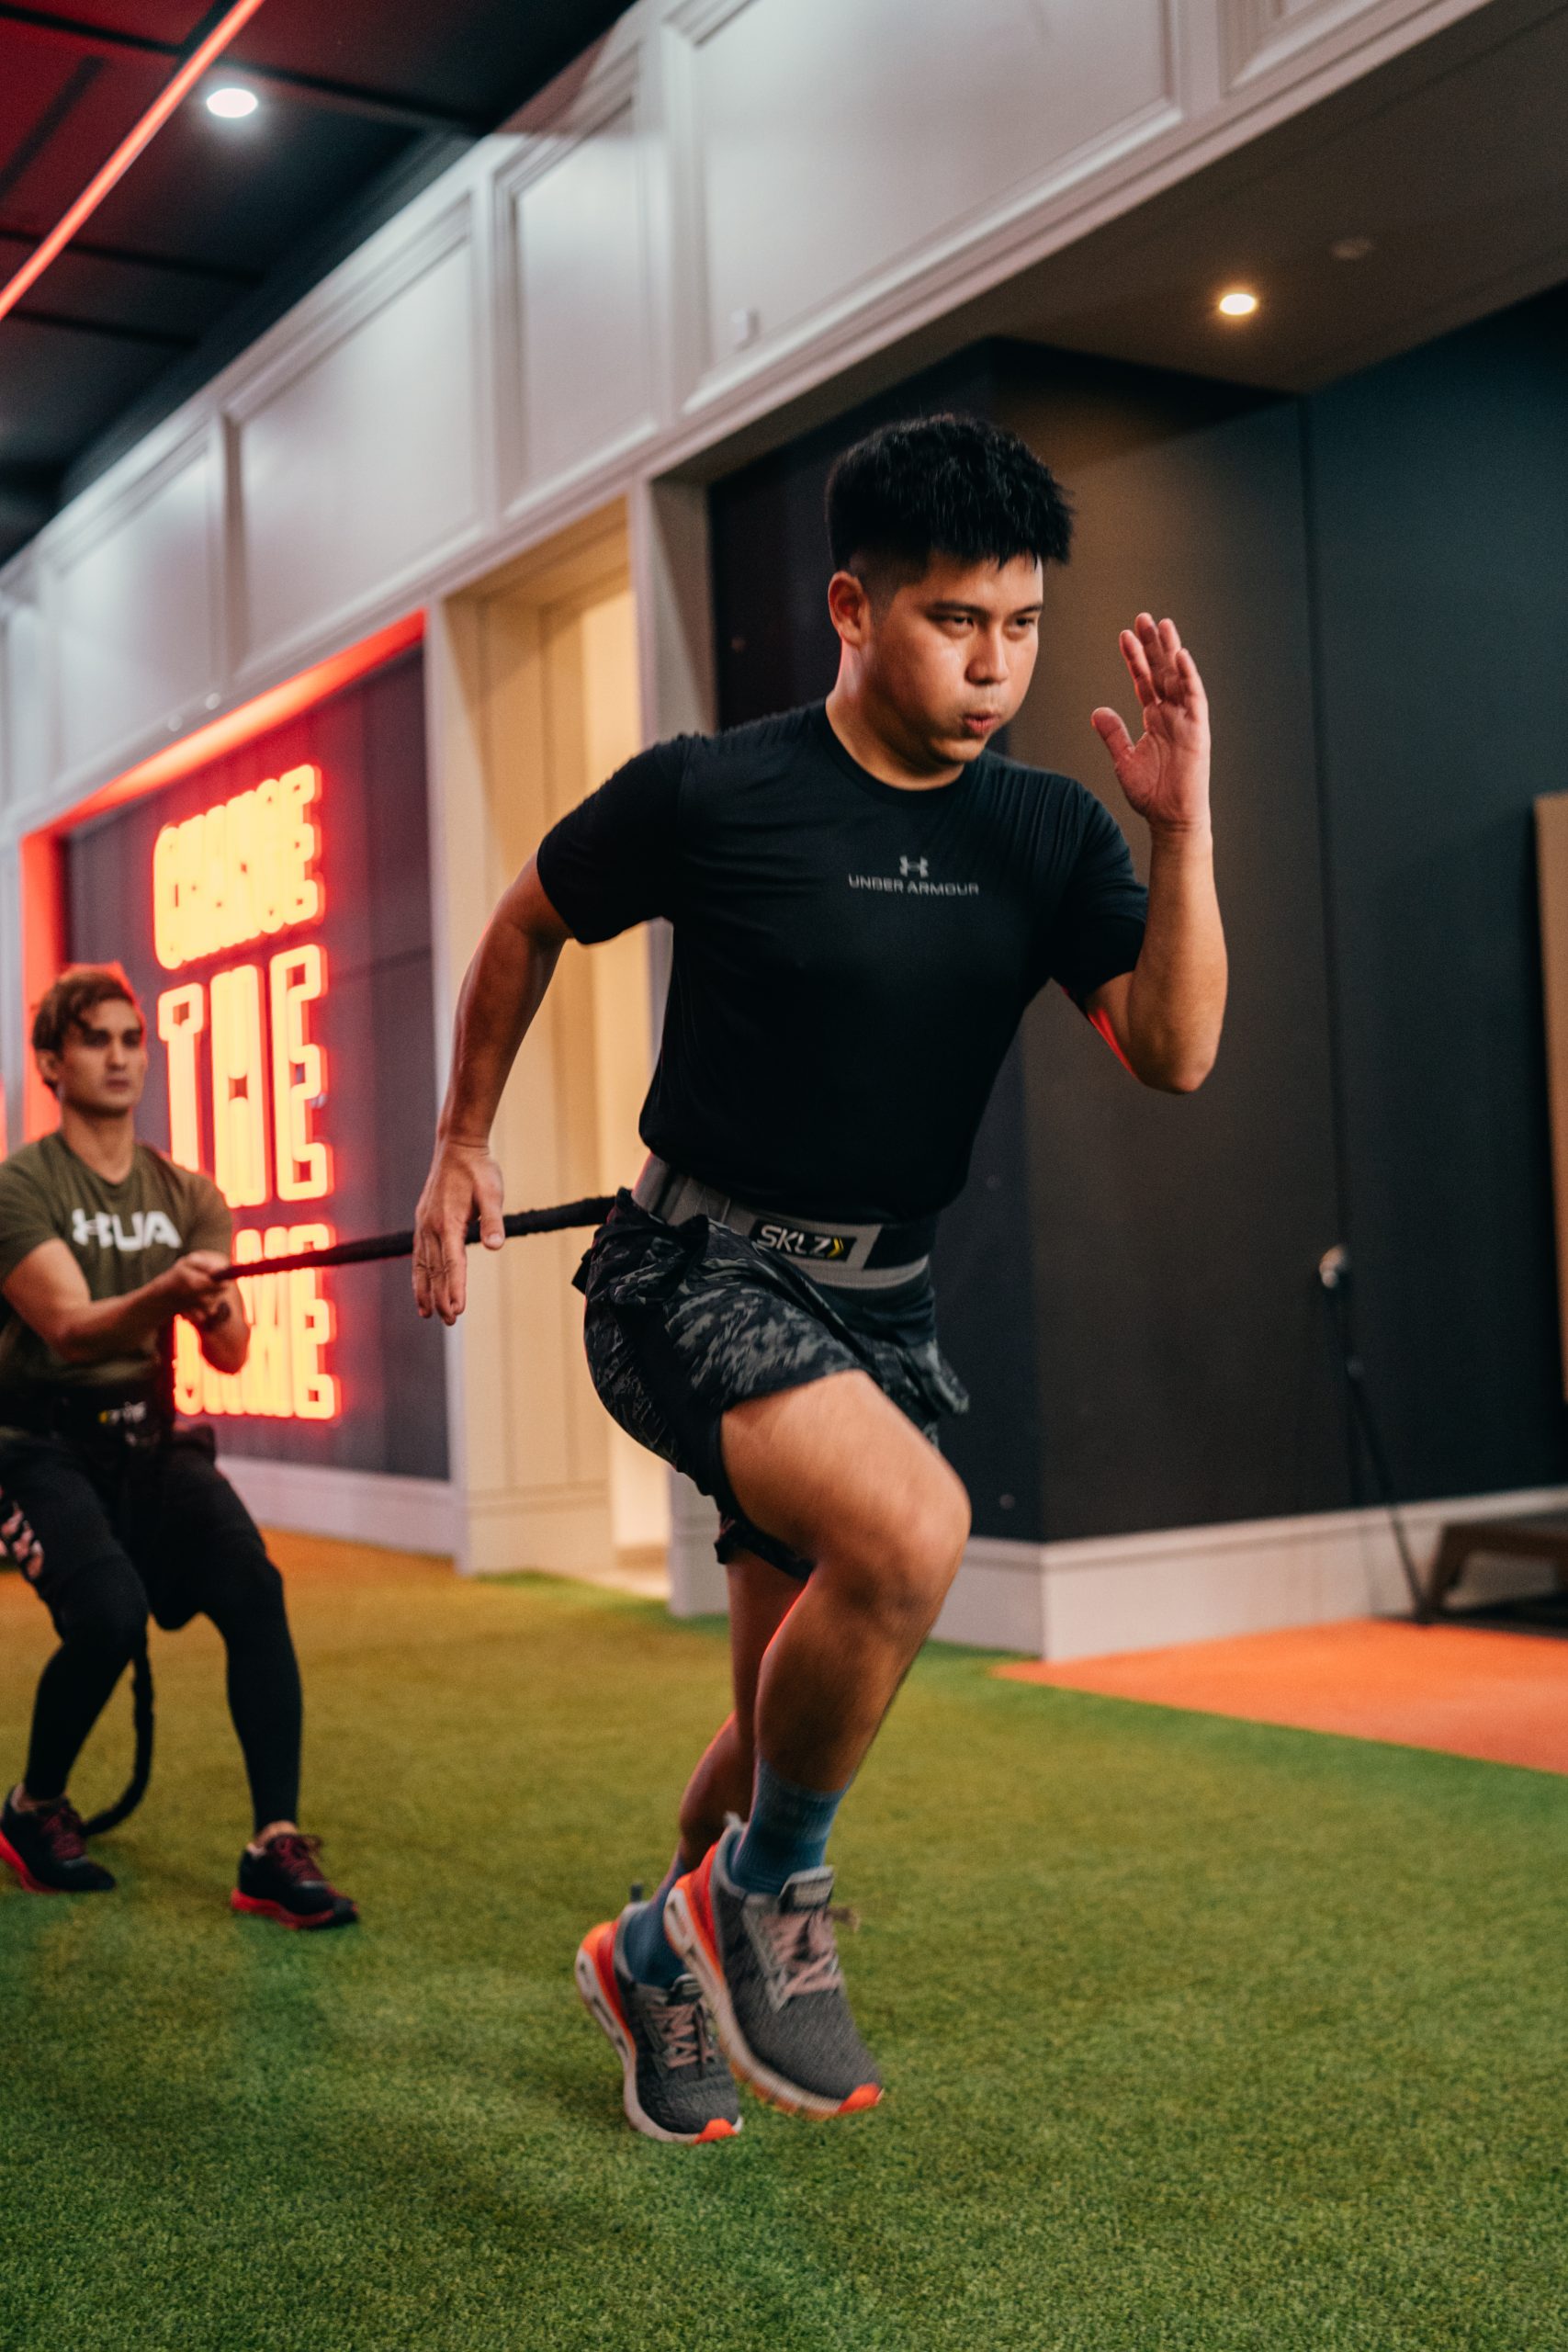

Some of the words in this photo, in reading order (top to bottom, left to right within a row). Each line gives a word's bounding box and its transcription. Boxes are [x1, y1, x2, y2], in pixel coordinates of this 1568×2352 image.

[848, 873, 904, 893] UNDER
[907, 880, 979, 896] ARMOUR
[157, 943, 333, 1209] THE
[760, 1224, 832, 1258] SKLZ
